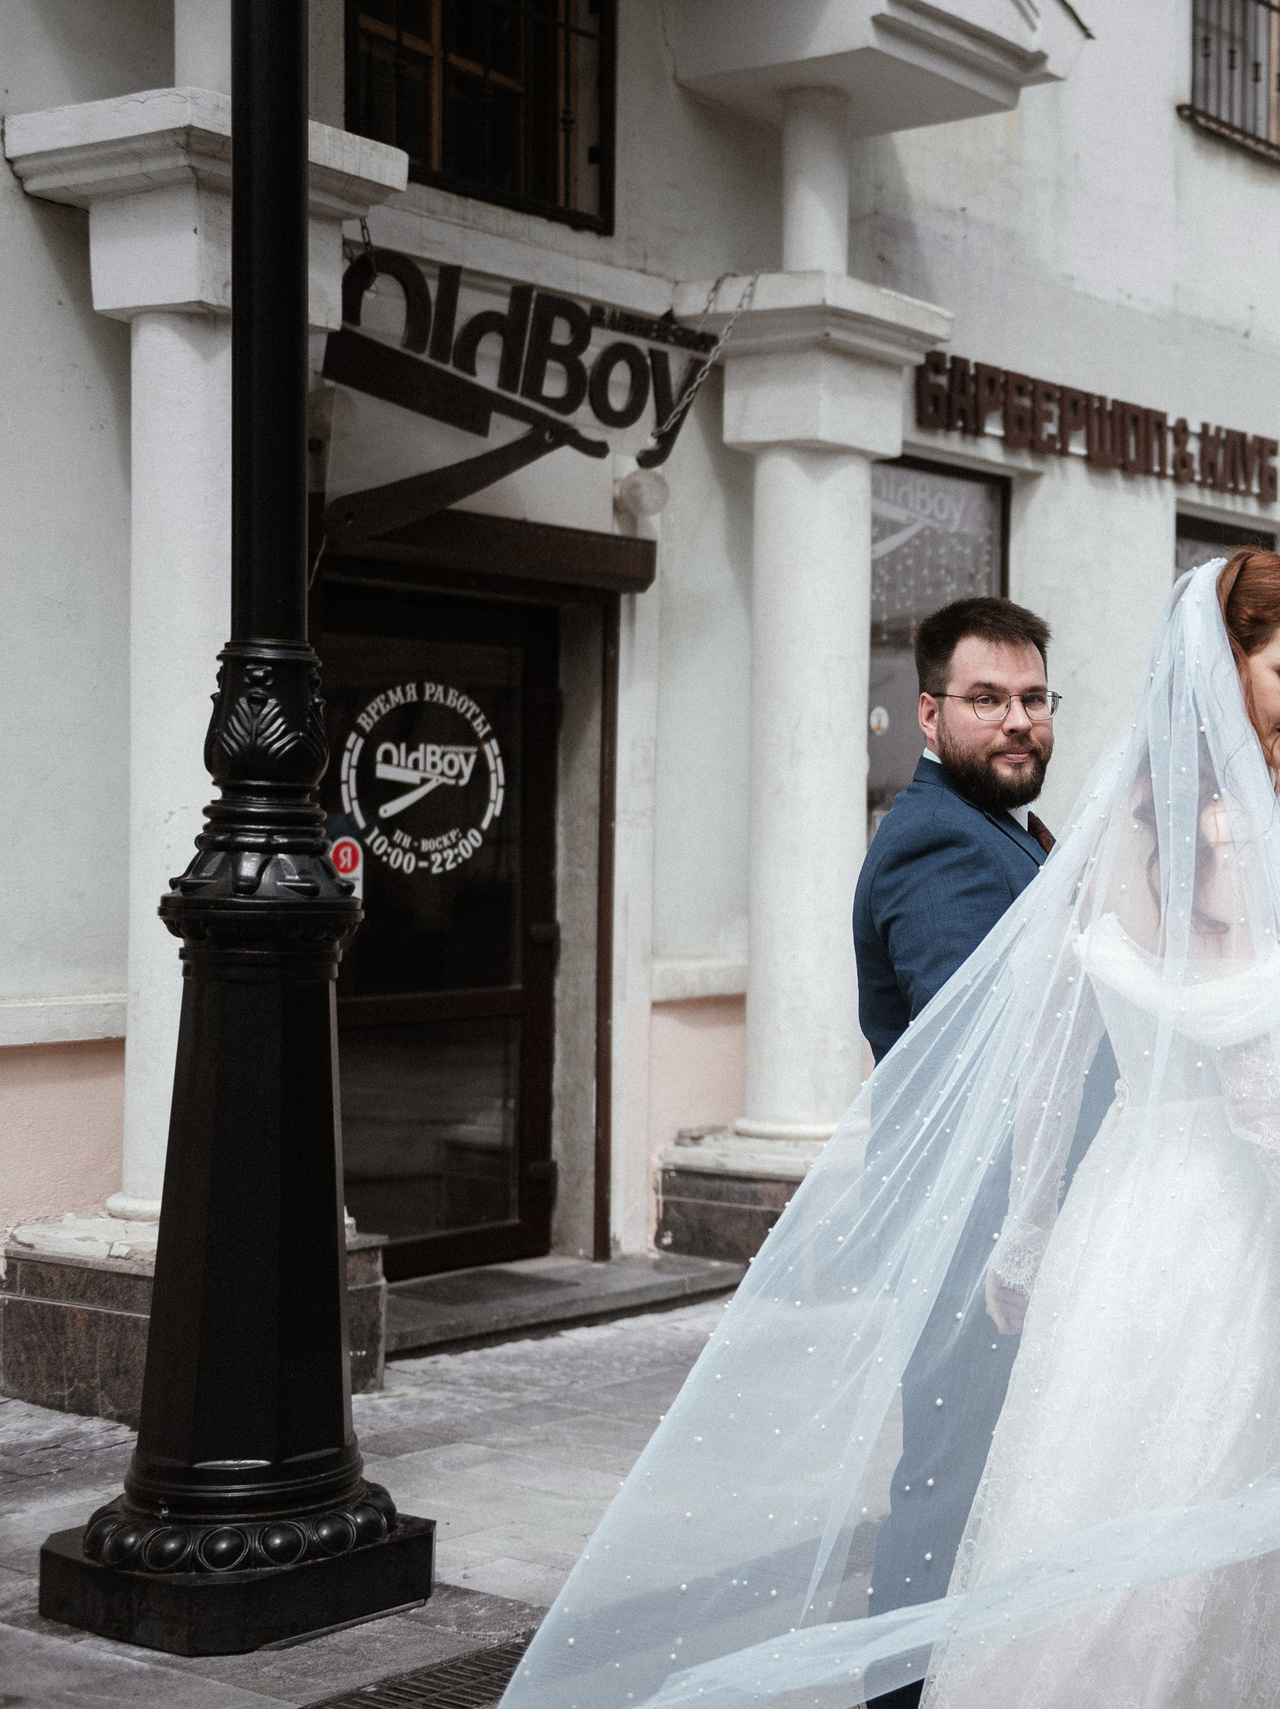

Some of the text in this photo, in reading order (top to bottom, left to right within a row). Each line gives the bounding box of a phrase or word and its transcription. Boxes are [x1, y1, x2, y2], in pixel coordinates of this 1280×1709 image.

[342, 249, 706, 469] OldBoy
[914, 350, 1280, 503] БАРБЕРШОП & КЛУБ
[356, 681, 493, 739] ВРЕМЯ РАБОТЫ
[376, 741, 477, 786] OldBoy
[339, 846, 352, 869] Я
